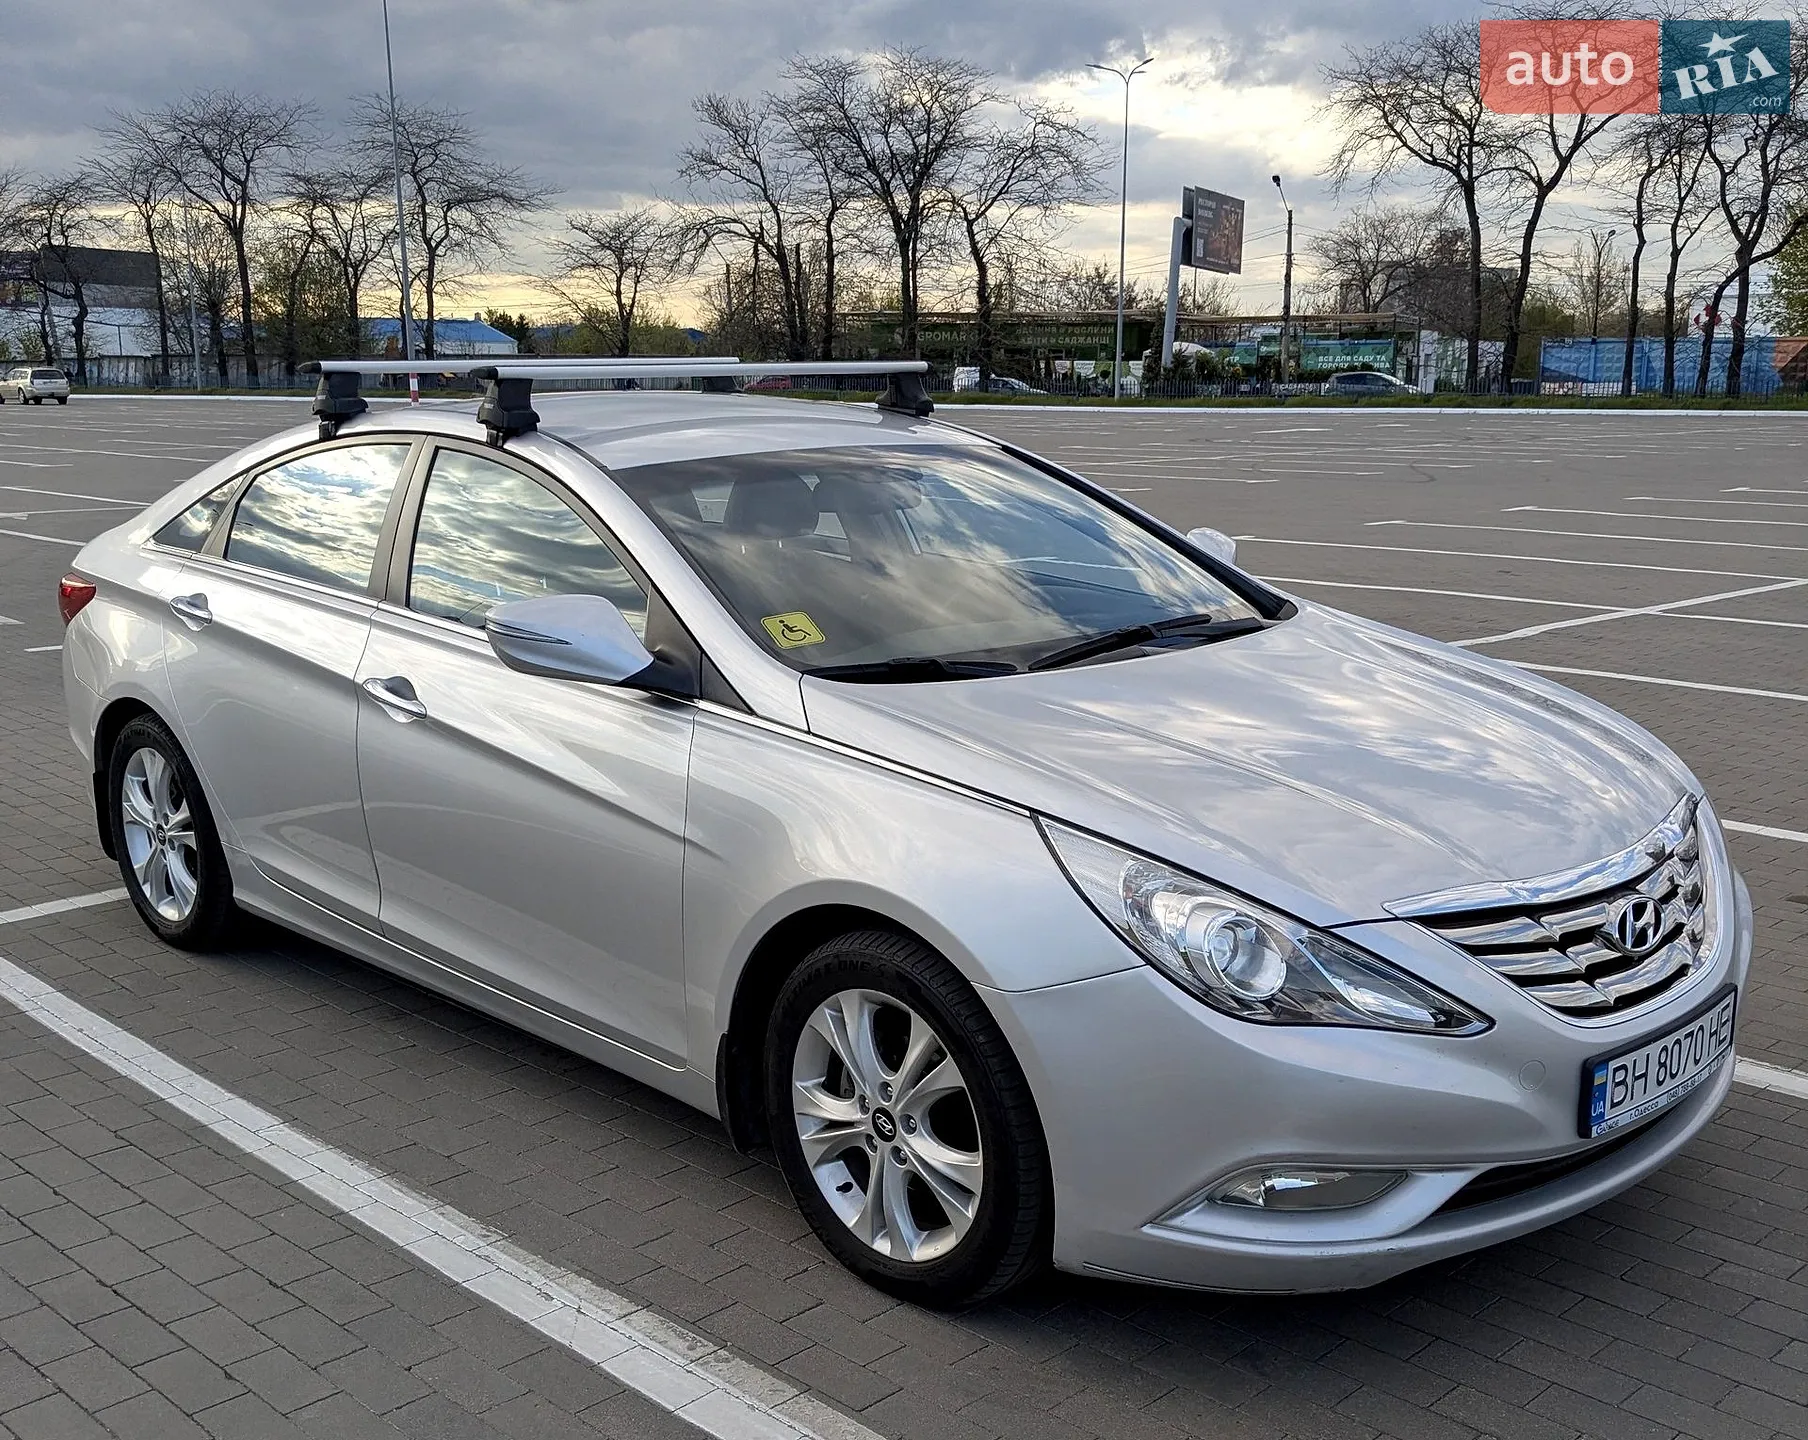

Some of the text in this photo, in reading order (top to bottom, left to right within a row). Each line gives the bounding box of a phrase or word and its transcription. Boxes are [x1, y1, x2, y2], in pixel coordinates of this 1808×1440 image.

[1335, 355, 1351, 363] ДЛЯ
[1353, 355, 1374, 363] САДУ
[1609, 1053, 1651, 1110] BH
[1656, 1024, 1705, 1087] 8070
[1707, 1001, 1731, 1057] HE
[1591, 1100, 1605, 1117] UA
